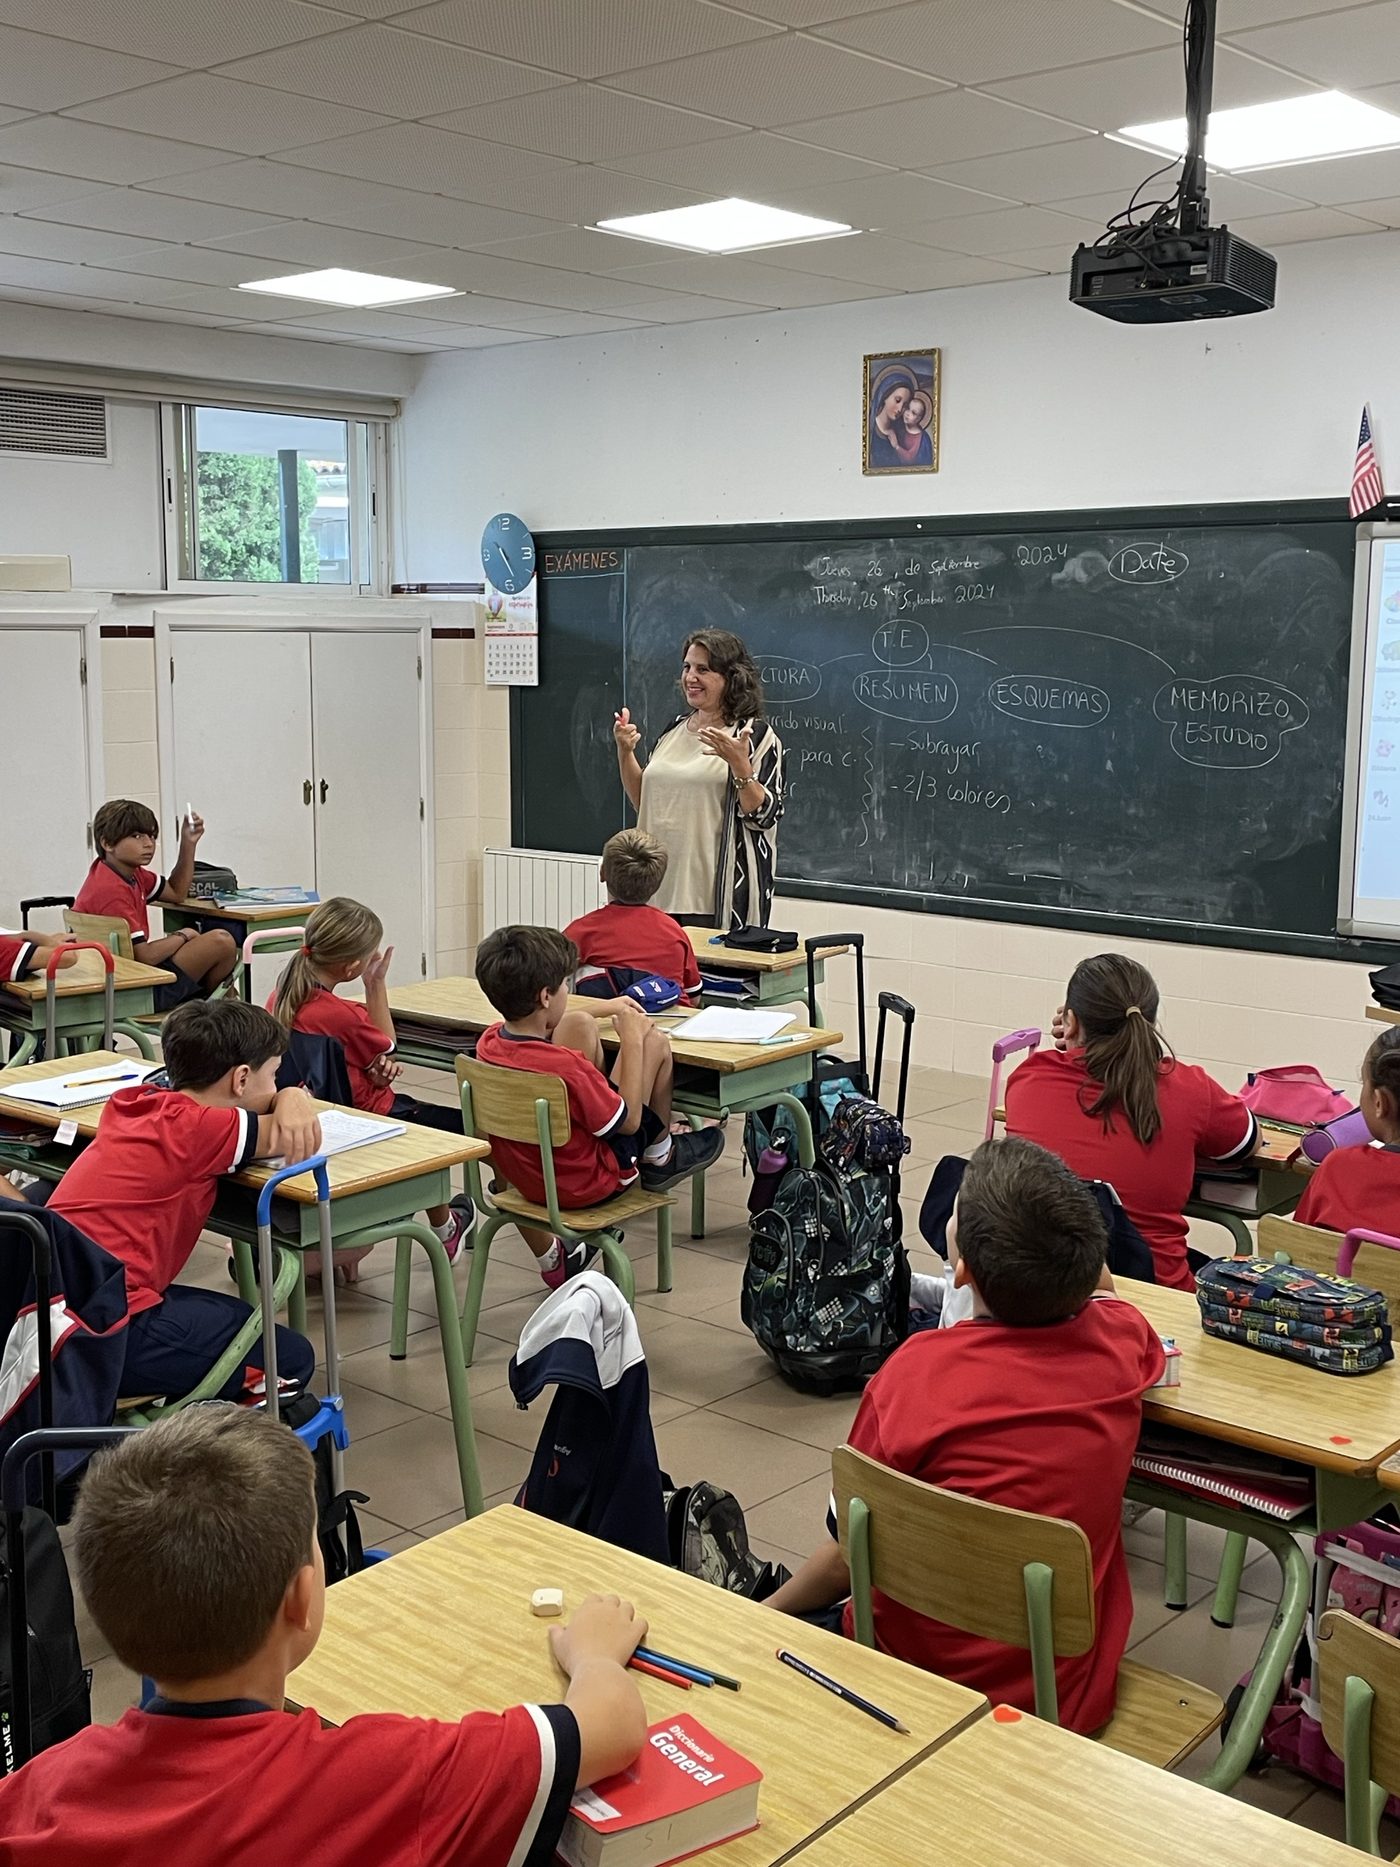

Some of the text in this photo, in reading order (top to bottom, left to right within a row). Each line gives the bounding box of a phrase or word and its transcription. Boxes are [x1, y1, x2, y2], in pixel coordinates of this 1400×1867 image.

[497, 517, 510, 531] 12
[520, 546, 533, 560] 3
[545, 551, 618, 574] EXÁMENES
[905, 558, 920, 576] de
[1016, 543, 1068, 567] 2024
[1121, 542, 1177, 574] Date
[504, 579, 515, 592] 6
[954, 583, 995, 604] 2024
[760, 665, 812, 686] CTURA
[858, 674, 949, 704] RESUMEN
[996, 682, 1103, 713] ESQUEMAS
[1170, 686, 1290, 718] MEMORIZO
[1185, 720, 1269, 751] ESTUDIO
[800, 748, 835, 773] para
[946, 780, 1011, 814] colores
[2, 1723, 14, 1776] KELME
[649, 1730, 726, 1787] General
[668, 1724, 716, 1764] Diccionario
